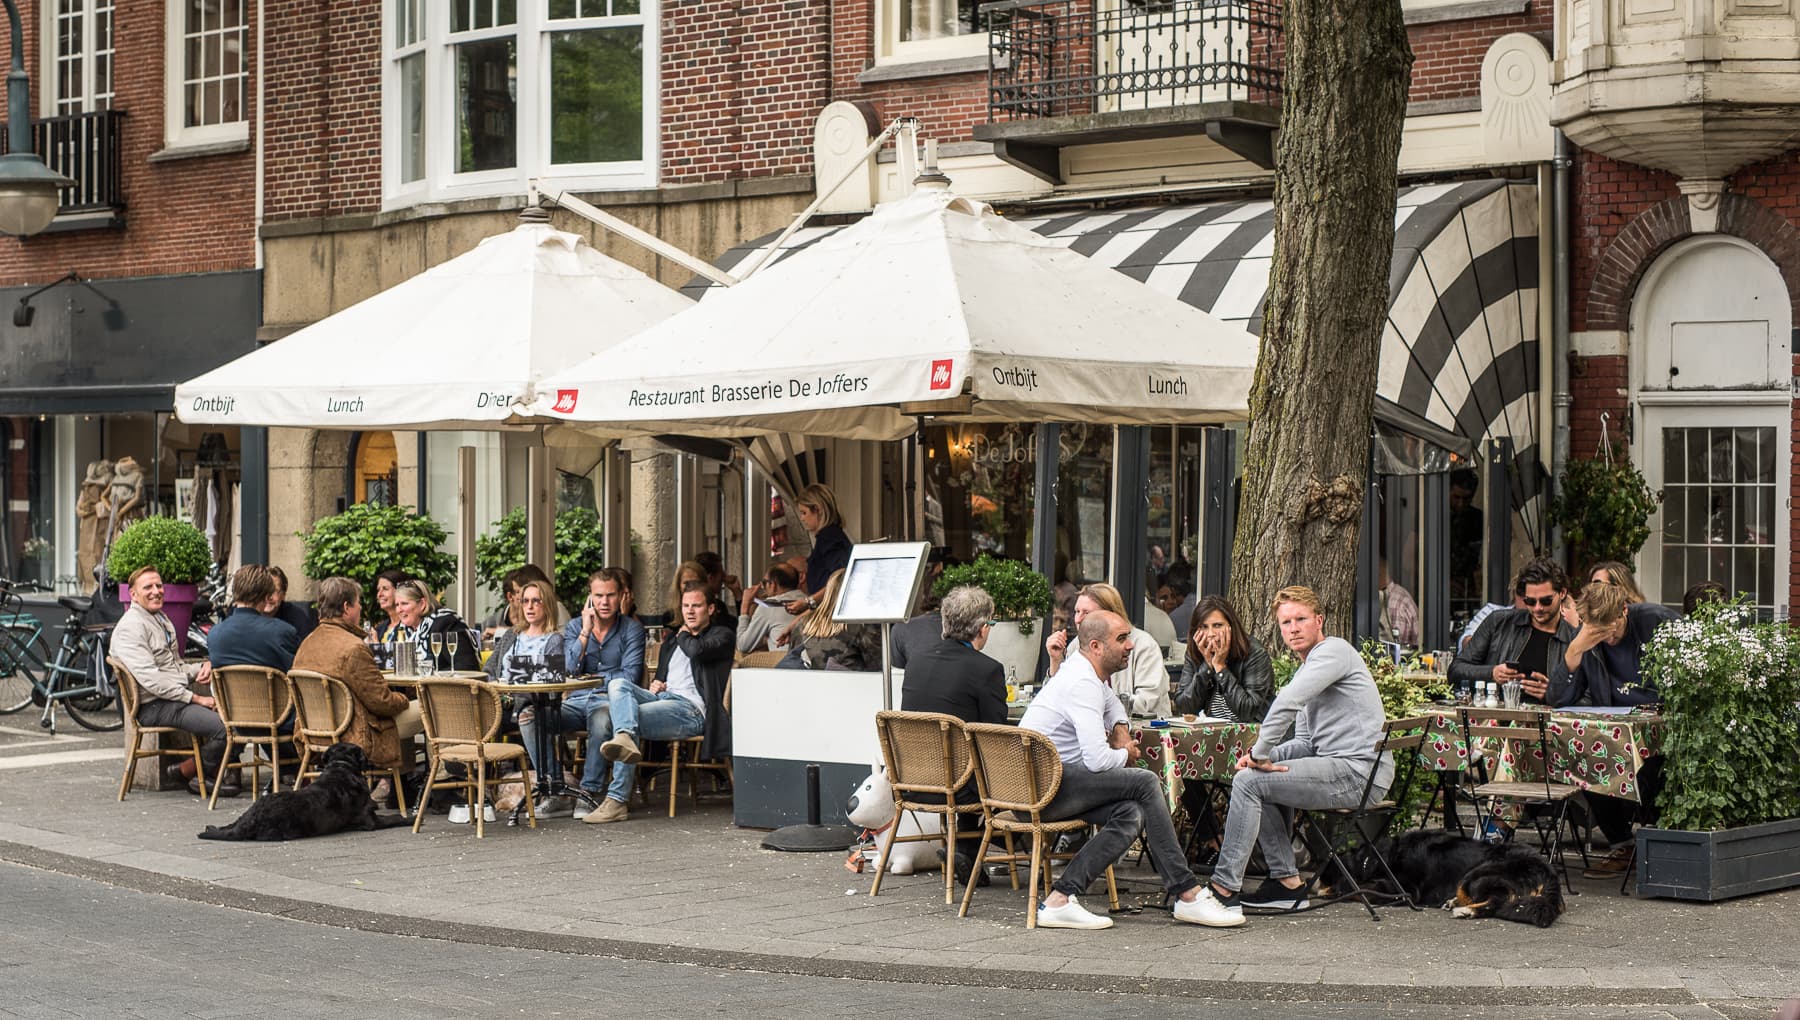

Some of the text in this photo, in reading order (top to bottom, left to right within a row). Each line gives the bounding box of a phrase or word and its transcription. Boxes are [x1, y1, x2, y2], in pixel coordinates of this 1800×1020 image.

[932, 364, 951, 386] illy
[992, 366, 1039, 391] Ontbijt
[1148, 375, 1188, 395] Lunch
[628, 373, 869, 407] Restaurant Brasserie De Joffers
[192, 396, 236, 415] Ontbijt
[327, 396, 364, 413] Lunch
[973, 433, 1000, 463] De
